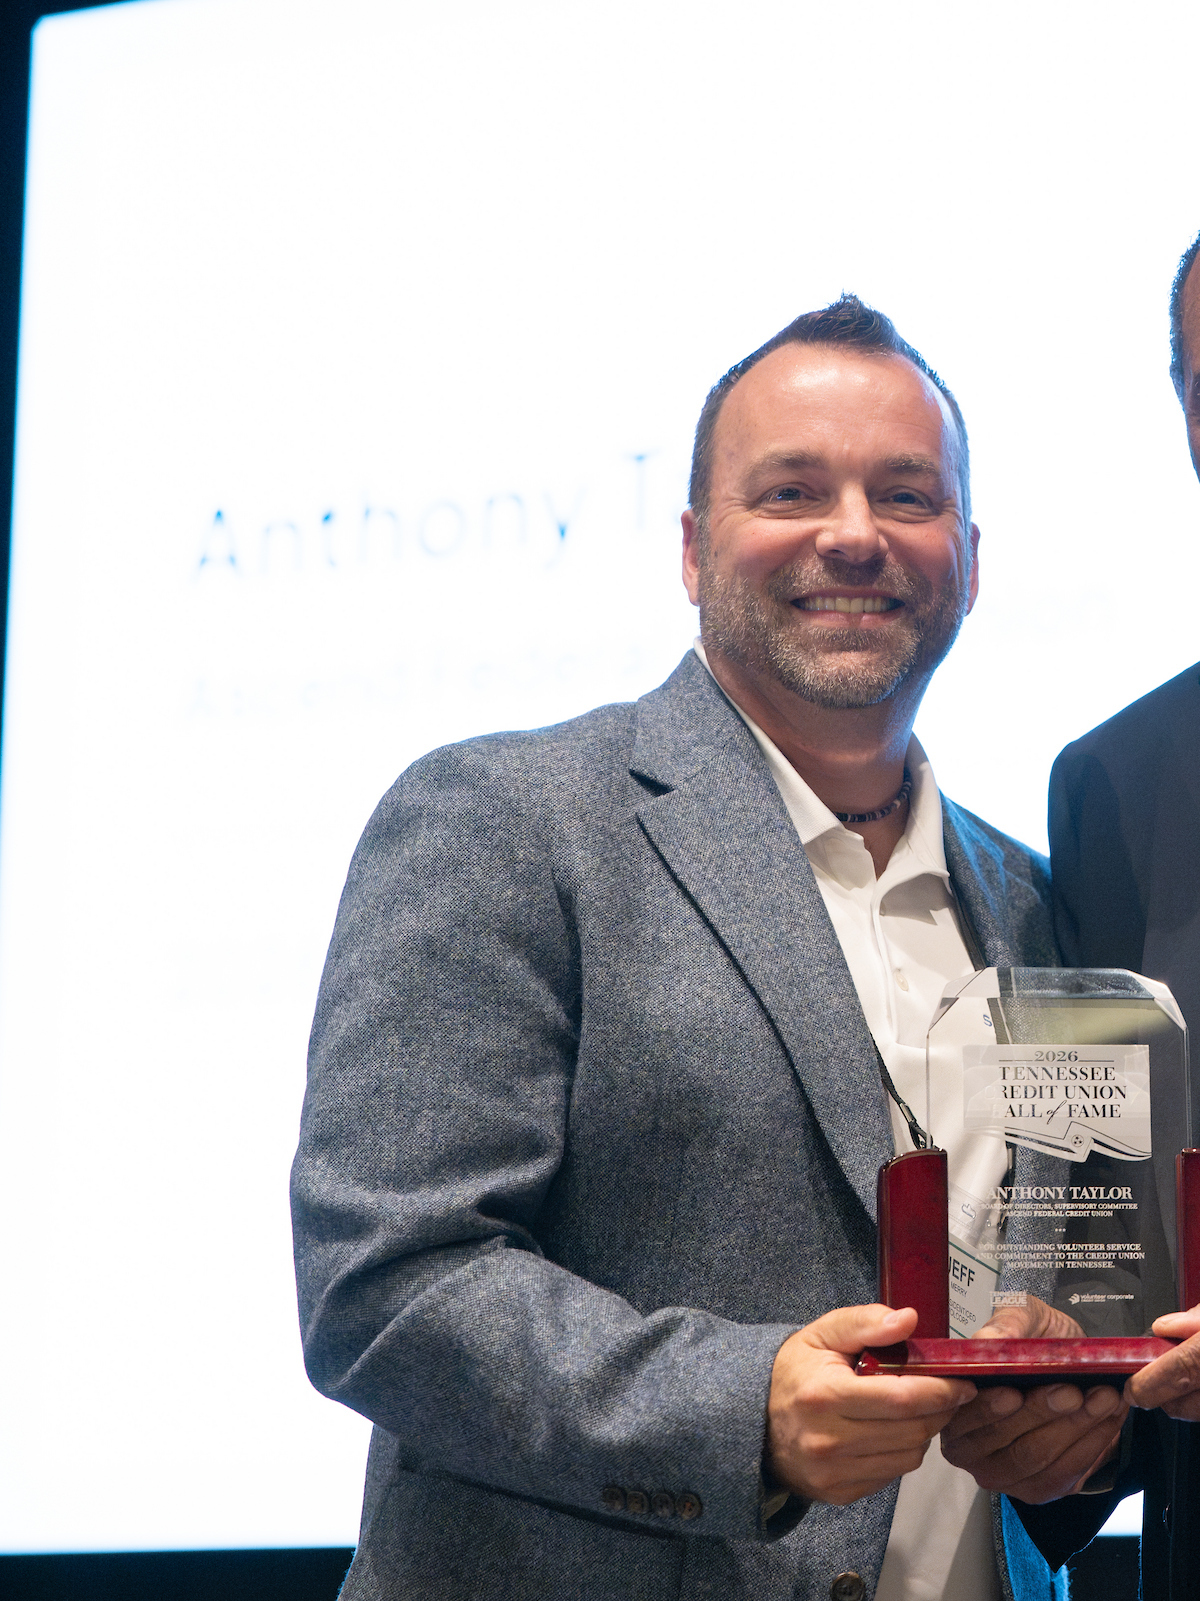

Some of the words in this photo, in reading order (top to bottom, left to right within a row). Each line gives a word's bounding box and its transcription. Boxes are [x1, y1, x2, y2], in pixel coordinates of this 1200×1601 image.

[190, 484, 589, 584] Anthony
[1034, 1050, 1079, 1062] 2026
[999, 1066, 1116, 1081] TENNESSEE
[1000, 1085, 1058, 1099] REDIT
[1064, 1085, 1127, 1099] UNION
[1003, 1103, 1043, 1118] ALL
[1046, 1099, 1067, 1125] of
[1068, 1104, 1121, 1118] FAME
[986, 1186, 1066, 1200] ANTHONY
[1069, 1186, 1133, 1200] TAYLOR
[997, 1243, 1055, 1251] OUTSTANDING
[1057, 1243, 1105, 1251] VOLUNTEER
[1106, 1243, 1141, 1251] SERVICE
[994, 1252, 1053, 1260] COMMITMENT
[1054, 1252, 1066, 1260] TO
[1066, 1252, 1084, 1260] THE
[1085, 1252, 1117, 1260] CREDIT
[1118, 1252, 1145, 1260] UNION
[1007, 1261, 1053, 1269] MOVEMENT
[1066, 1261, 1116, 1269] TENNESSEE.
